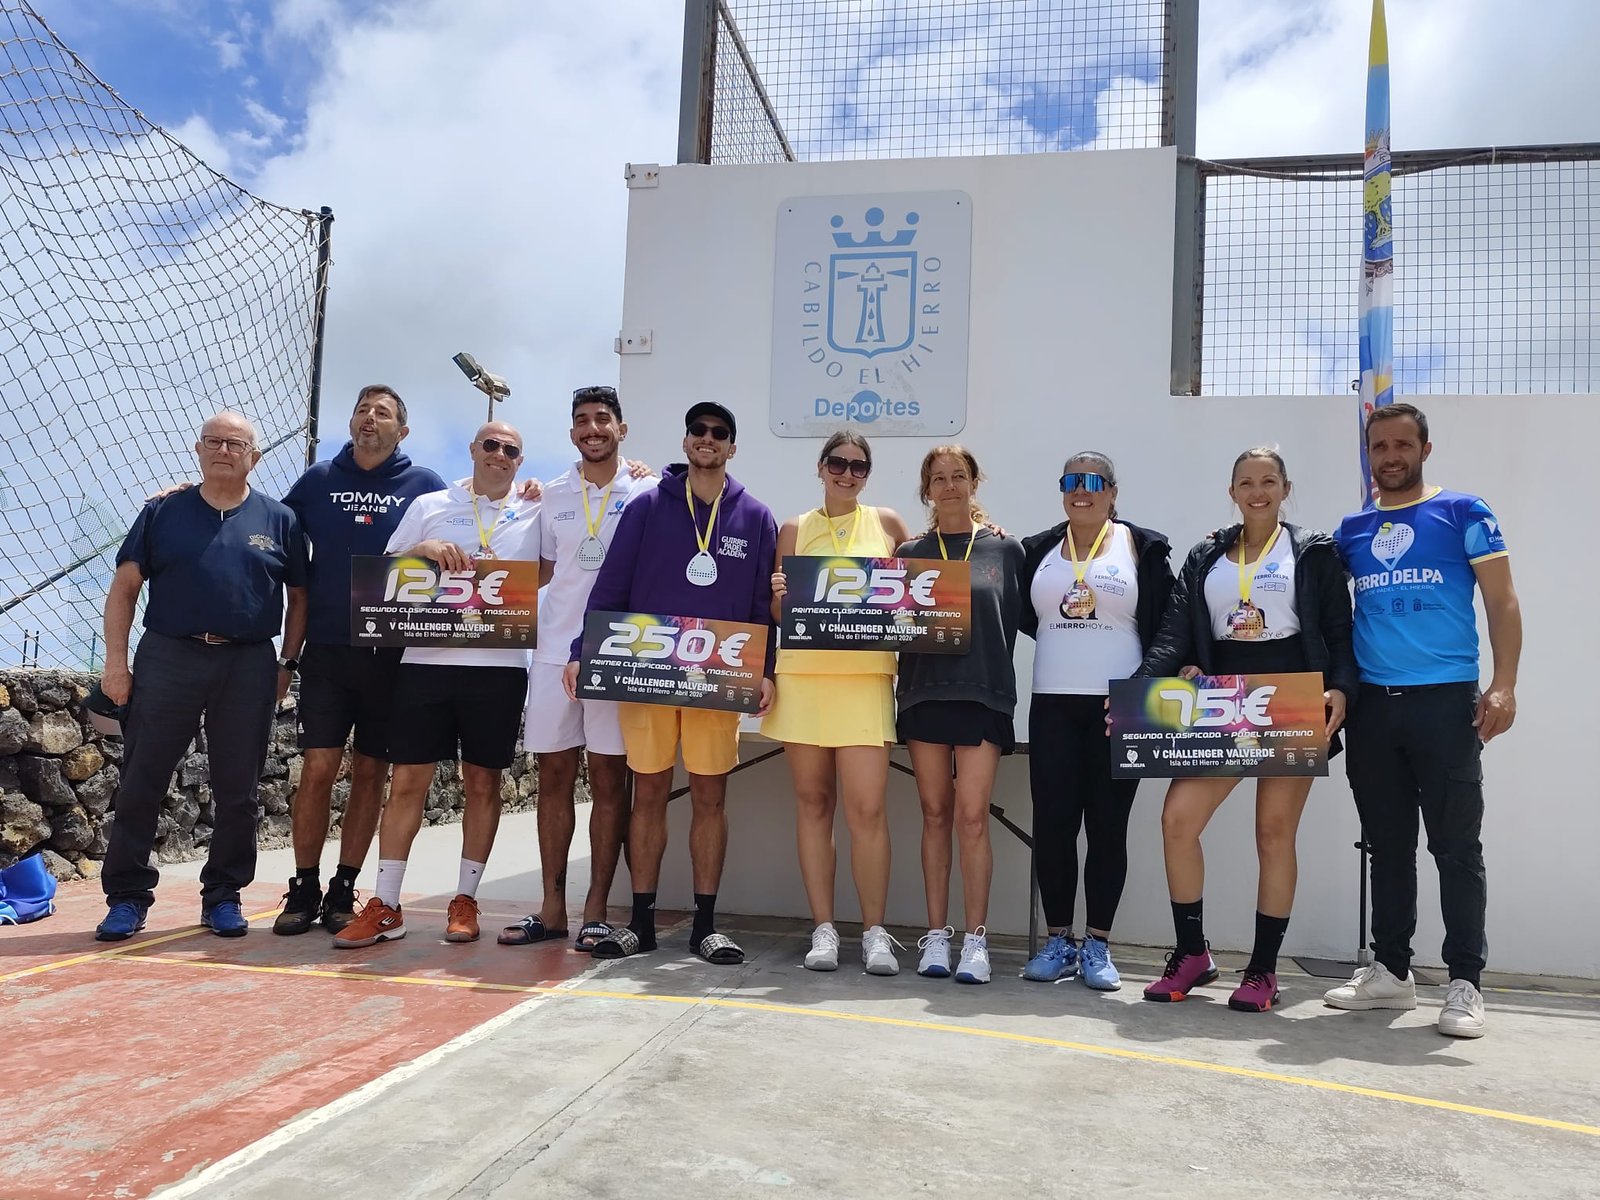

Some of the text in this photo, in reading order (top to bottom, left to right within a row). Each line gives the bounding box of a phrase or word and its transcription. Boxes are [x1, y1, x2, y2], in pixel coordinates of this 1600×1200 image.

[802, 257, 942, 384] CABILDO EL HIERRO
[814, 398, 920, 422] Deportes
[330, 492, 406, 506] TOMMY
[342, 504, 388, 513] JEANS
[1392, 568, 1444, 584] DELPA
[384, 568, 510, 605] 125€
[814, 568, 941, 606] 125€
[390, 622, 495, 632] V CHALLENGER VALVERDE
[820, 624, 928, 635] V CHALLENGER VALVERDE
[590, 659, 622, 667] PRIMER
[622, 661, 672, 670] CLASIFICADO
[706, 668, 753, 678] MASCULINO
[614, 676, 718, 692] V CHALLENGER VALVERDE
[1160, 686, 1278, 726] 75€
[1152, 748, 1275, 758] V CHALLENGER VALVERDE
